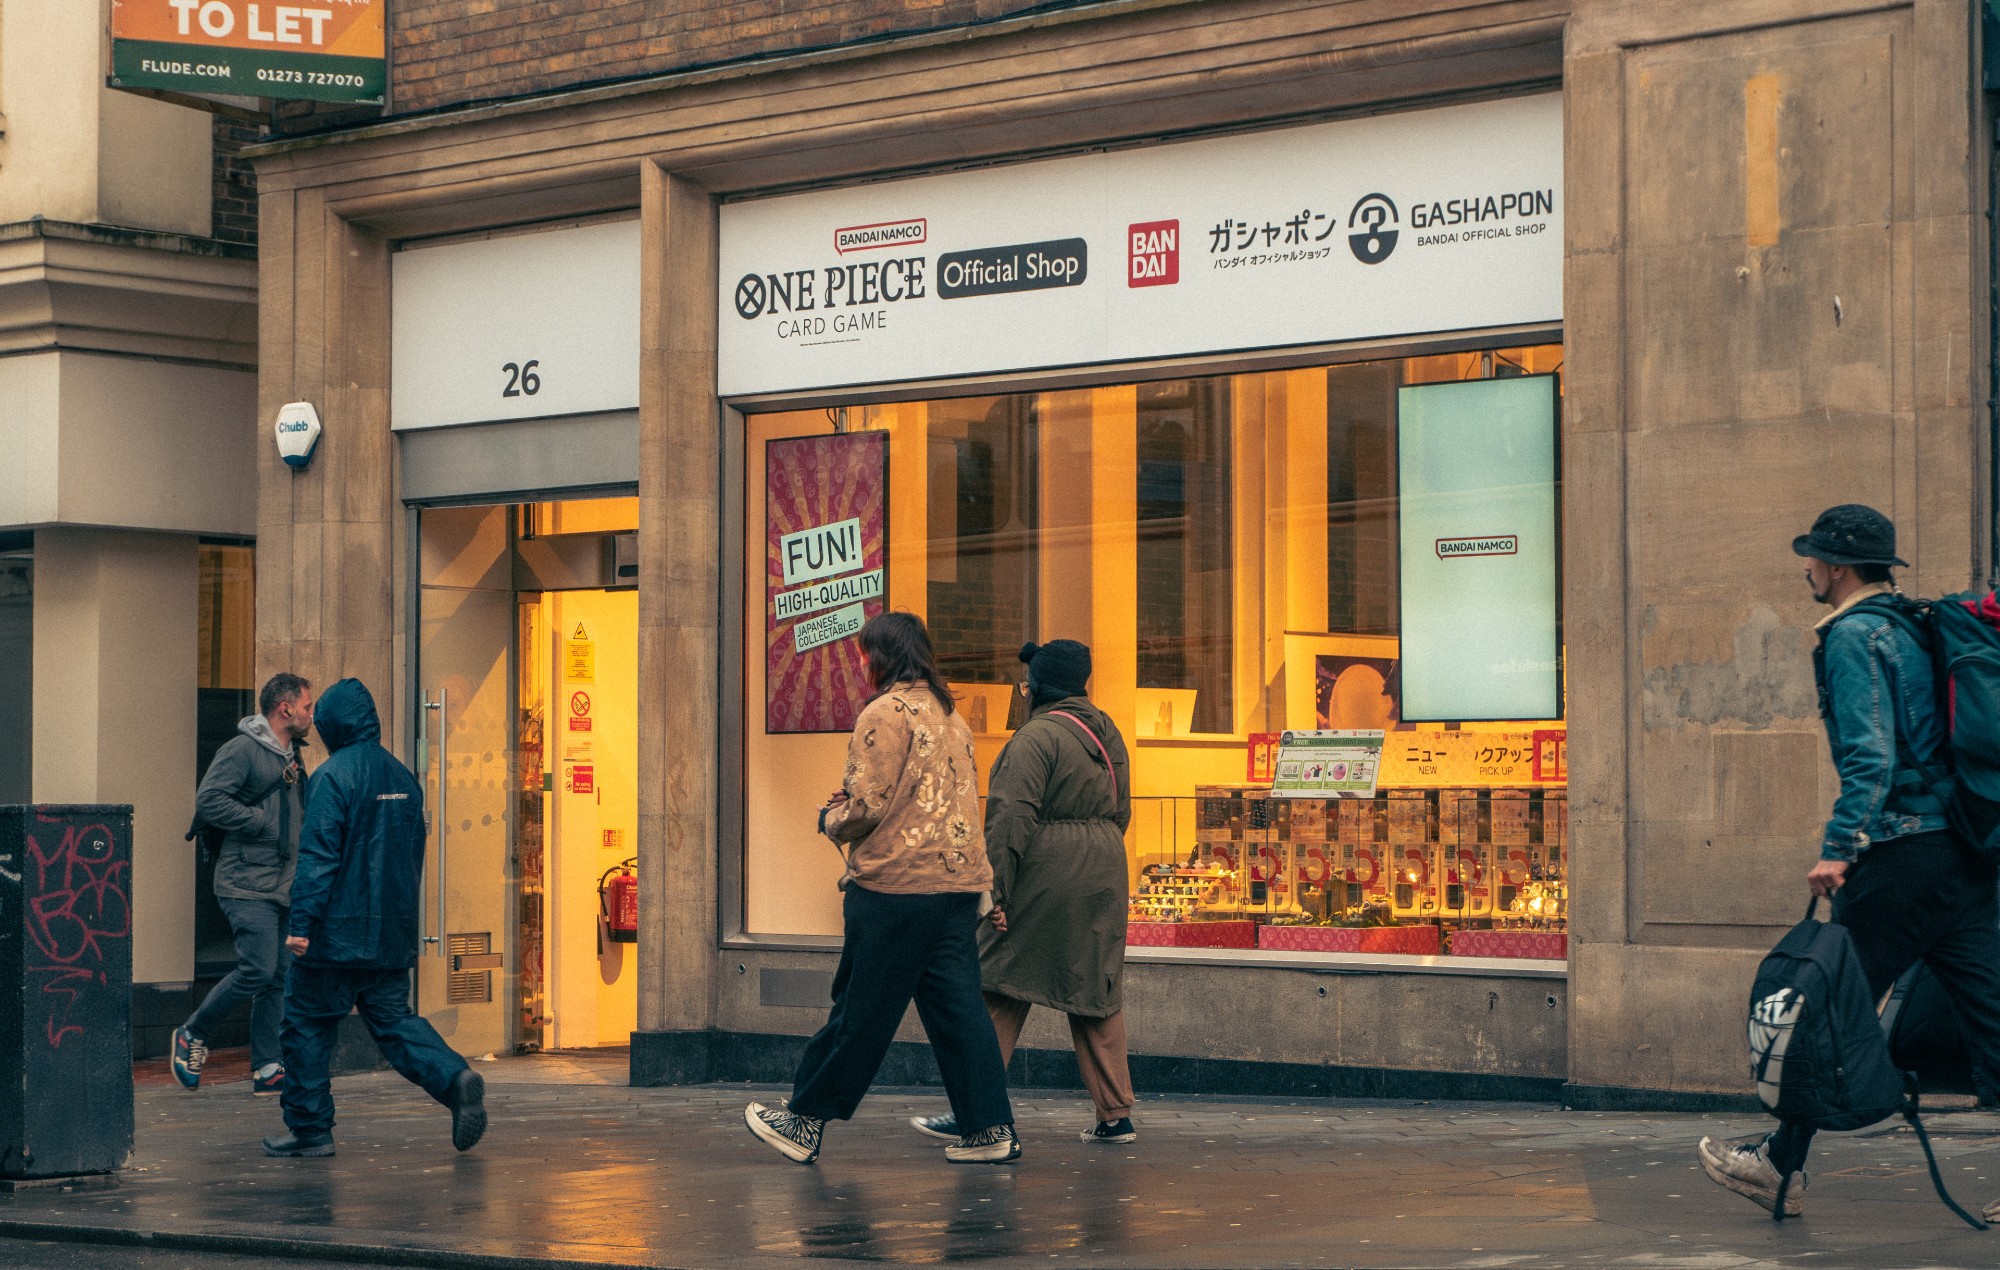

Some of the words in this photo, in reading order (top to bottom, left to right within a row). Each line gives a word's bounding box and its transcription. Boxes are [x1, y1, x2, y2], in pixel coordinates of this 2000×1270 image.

[169, 0, 235, 38] TO
[247, 3, 333, 45] LET
[142, 59, 231, 78] FLUDE.COM
[256, 68, 303, 84] 01273
[307, 72, 364, 87] 727070
[1411, 188, 1553, 230] GASHAPON
[839, 229, 880, 247] BANDAI
[880, 224, 922, 241] NAMCO
[1132, 228, 1176, 255] BAN
[1208, 209, 1337, 255] ガシャポン
[1417, 233, 1459, 247] BANDAI
[1462, 227, 1512, 242] OFFICIAL
[1515, 222, 1547, 236] SHOP
[943, 253, 1019, 288] Official
[1026, 251, 1080, 286] Shop
[1132, 252, 1167, 279] DAI
[1213, 256, 1247, 270] バンダイ
[1250, 246, 1331, 267] オフィシャルショップ
[734, 269, 816, 320] ONE
[823, 256, 926, 309] PIECE
[777, 314, 826, 339] CARD
[833, 310, 887, 333] GAME
[501, 359, 541, 398] 26
[278, 420, 309, 434] Chubb
[786, 525, 857, 576] FUN!
[1440, 542, 1476, 553] BANDAI
[1477, 540, 1513, 552] NAMCO
[777, 572, 881, 616] HIGH-QUALITY
[797, 612, 839, 638] JAPANESE
[797, 618, 859, 648] COLLECTABLES
[1406, 747, 1447, 763] ニュー
[1418, 765, 1437, 775] NEW
[1479, 766, 1500, 776] PICK
[1501, 766, 1514, 776] UP
